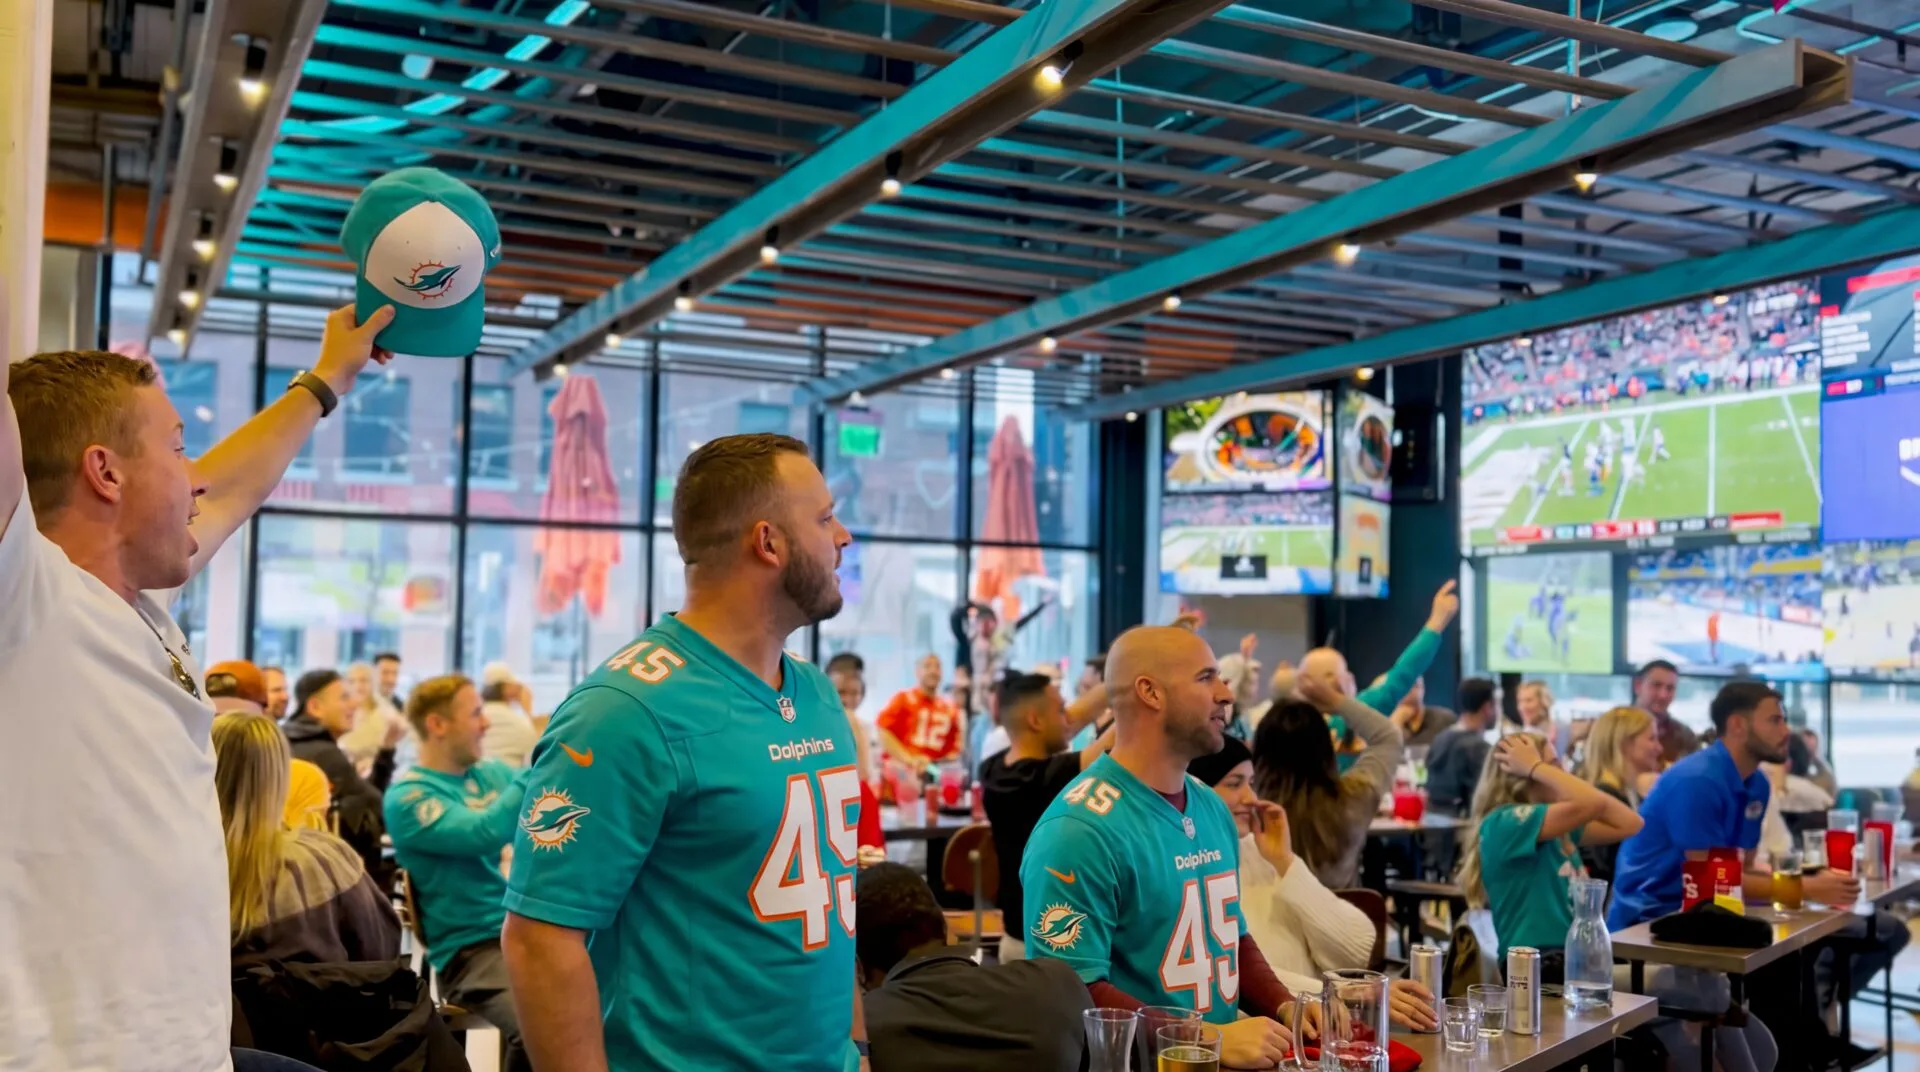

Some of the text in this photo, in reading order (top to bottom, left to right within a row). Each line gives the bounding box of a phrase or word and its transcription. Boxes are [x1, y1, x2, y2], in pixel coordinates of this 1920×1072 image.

[606, 642, 685, 683] 45
[768, 736, 835, 762] Dolphins
[911, 707, 952, 751] 12
[1064, 777, 1121, 815] 45
[748, 766, 860, 951] 45
[1174, 848, 1222, 871] Dolphins
[1160, 871, 1239, 1012] 45
